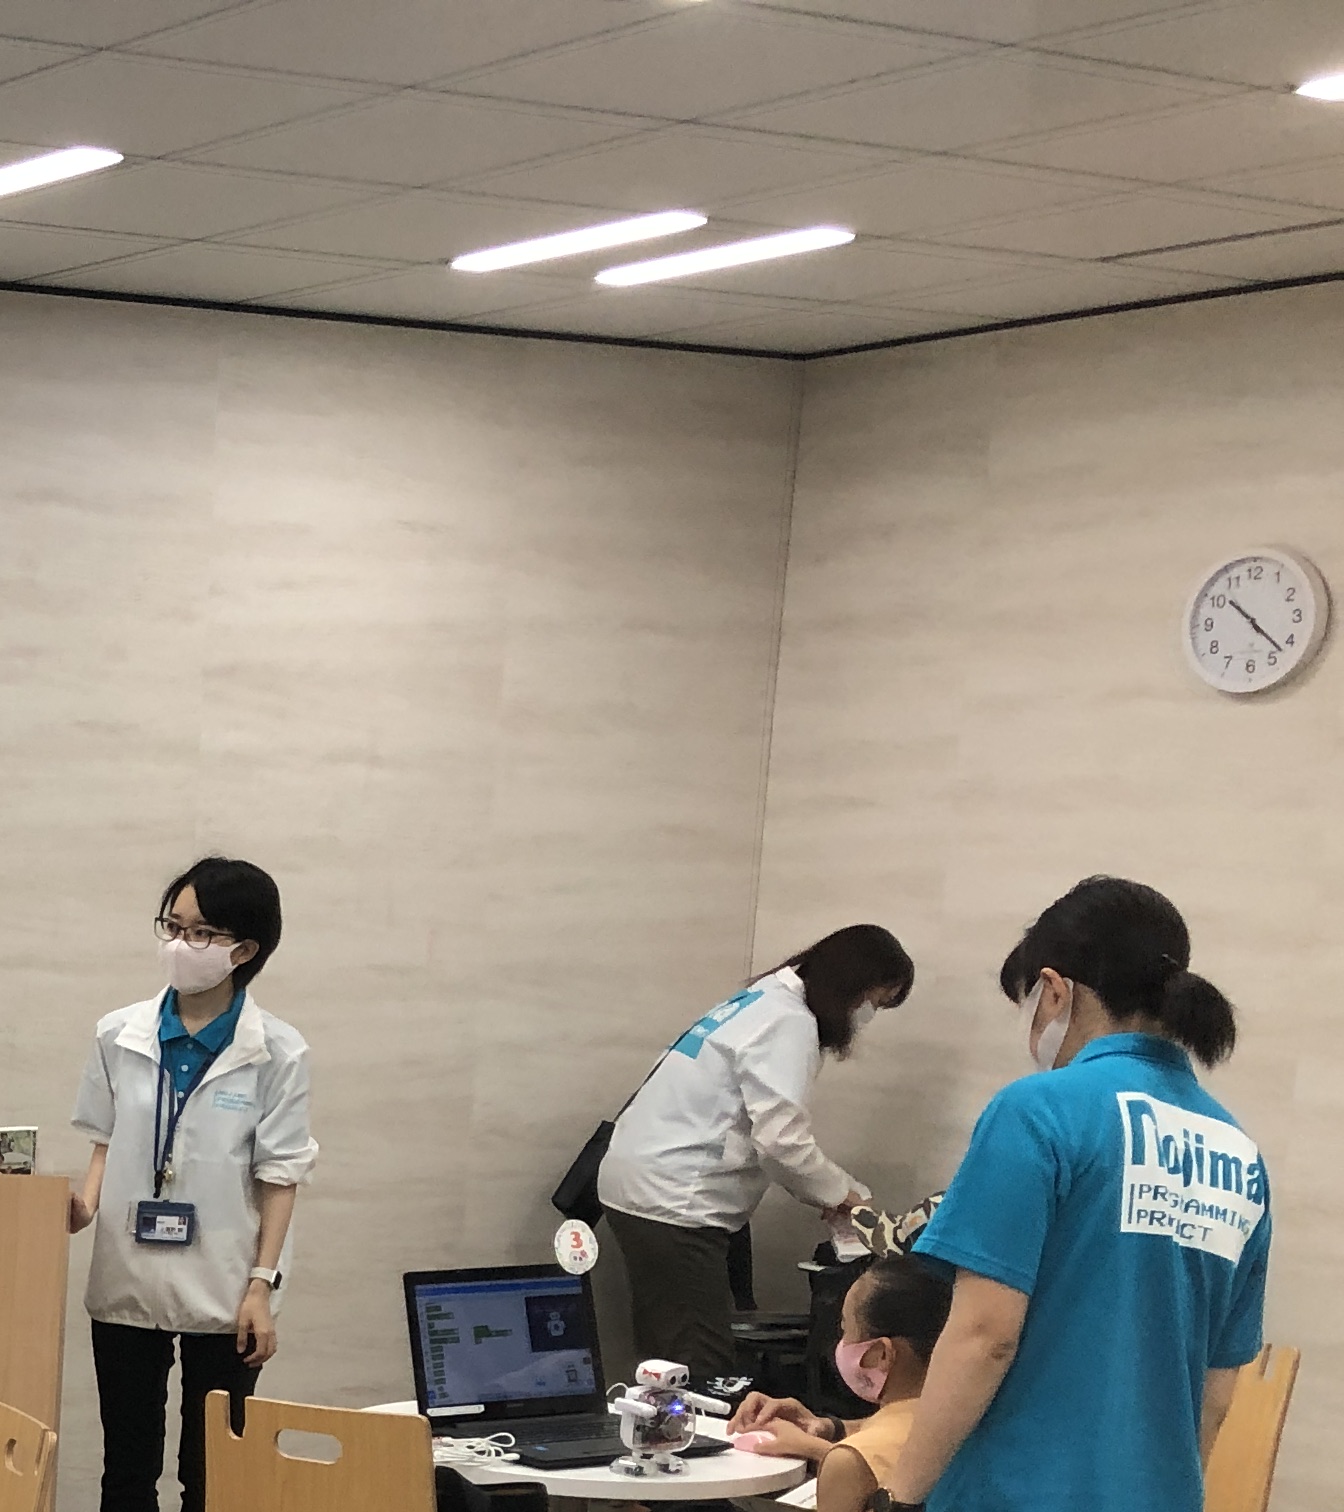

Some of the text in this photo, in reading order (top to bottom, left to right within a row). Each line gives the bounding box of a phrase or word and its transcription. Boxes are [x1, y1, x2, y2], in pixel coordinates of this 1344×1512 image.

[1247, 566, 1263, 580] 12
[1228, 576, 1240, 589] 11
[1210, 594, 1226, 608] 10
[1285, 588, 1296, 602] 2
[1292, 609, 1303, 623] 3
[1204, 618, 1214, 632] 9
[1210, 640, 1219, 654] 8
[1286, 634, 1295, 646] 4
[1224, 656, 1233, 670] 7
[1246, 659, 1256, 673] 6
[1267, 652, 1278, 666] 5
[570, 1231, 583, 1248] 3
